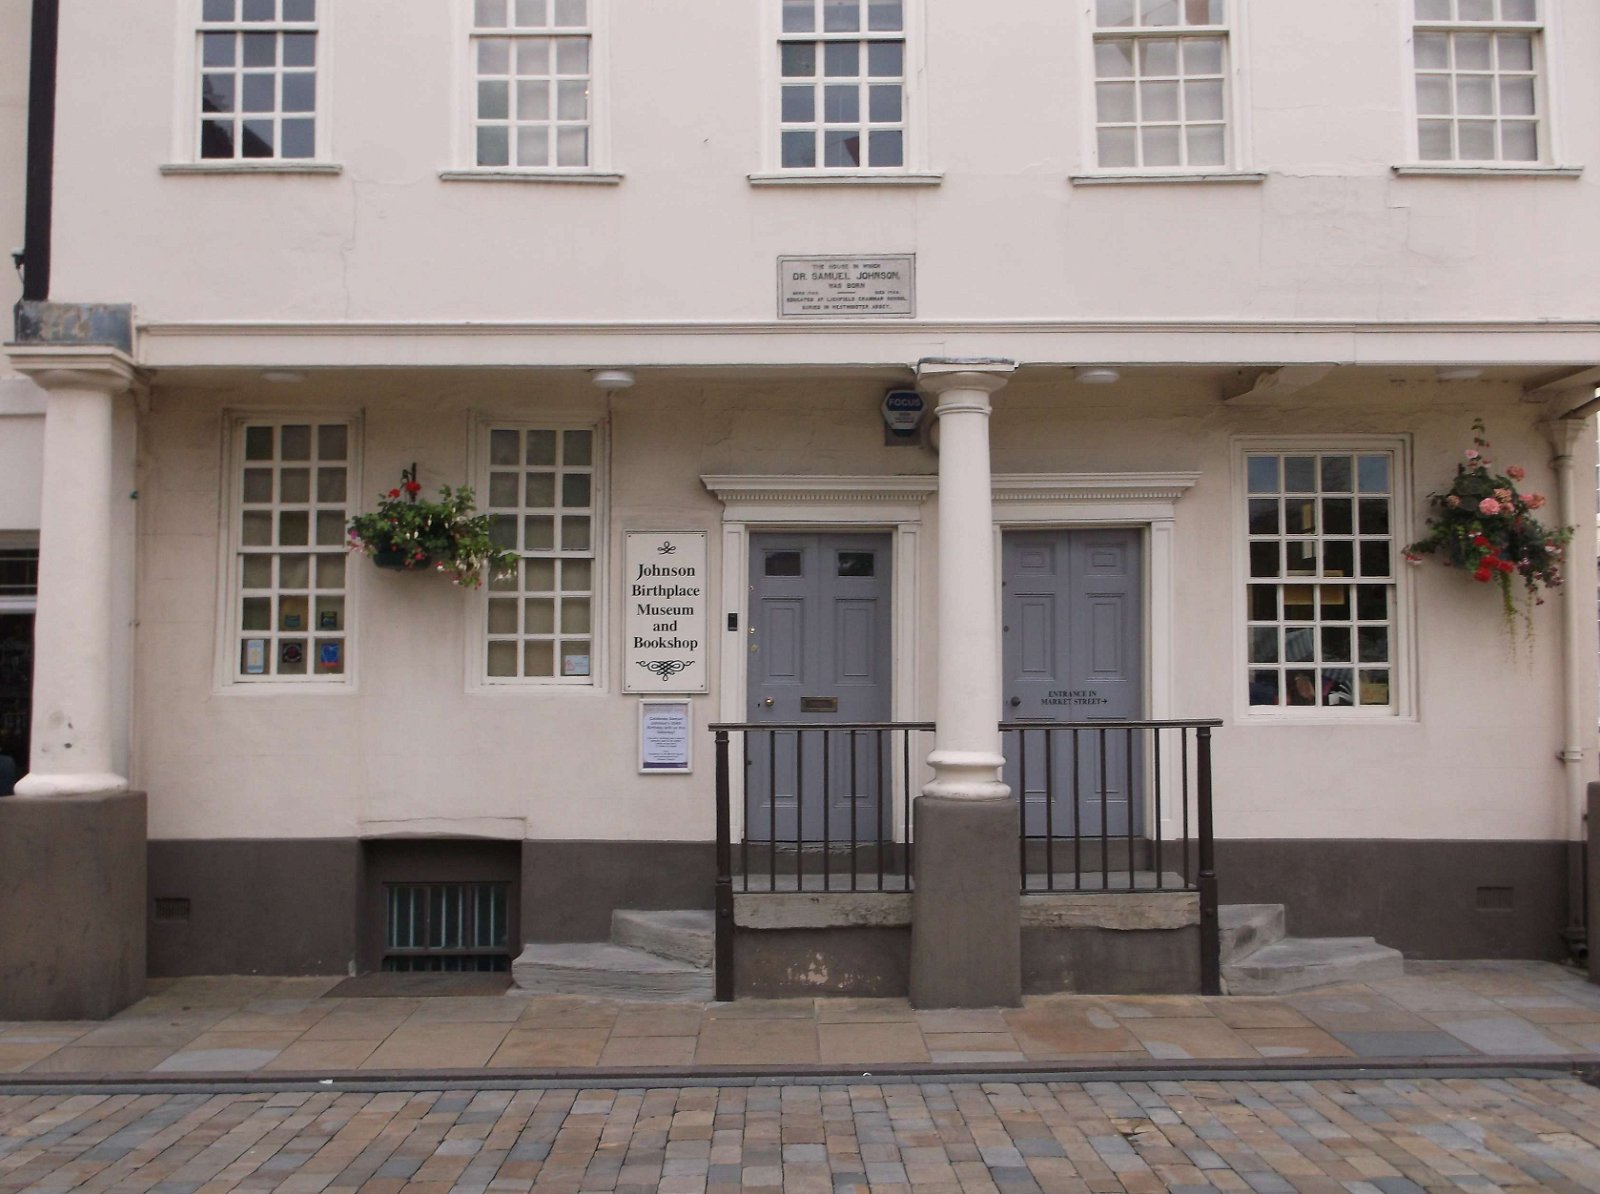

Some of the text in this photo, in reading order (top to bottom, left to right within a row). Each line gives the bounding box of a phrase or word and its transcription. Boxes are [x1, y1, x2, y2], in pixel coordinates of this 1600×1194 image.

[811, 271, 851, 281] SAMUEL
[888, 398, 922, 407] FOCUS
[636, 563, 696, 581] Johnson
[632, 584, 701, 599] Birthplace
[636, 603, 694, 616] Museum
[652, 620, 678, 632] and
[633, 636, 698, 651] Bookshop
[1048, 690, 1087, 698] ENTRANCE
